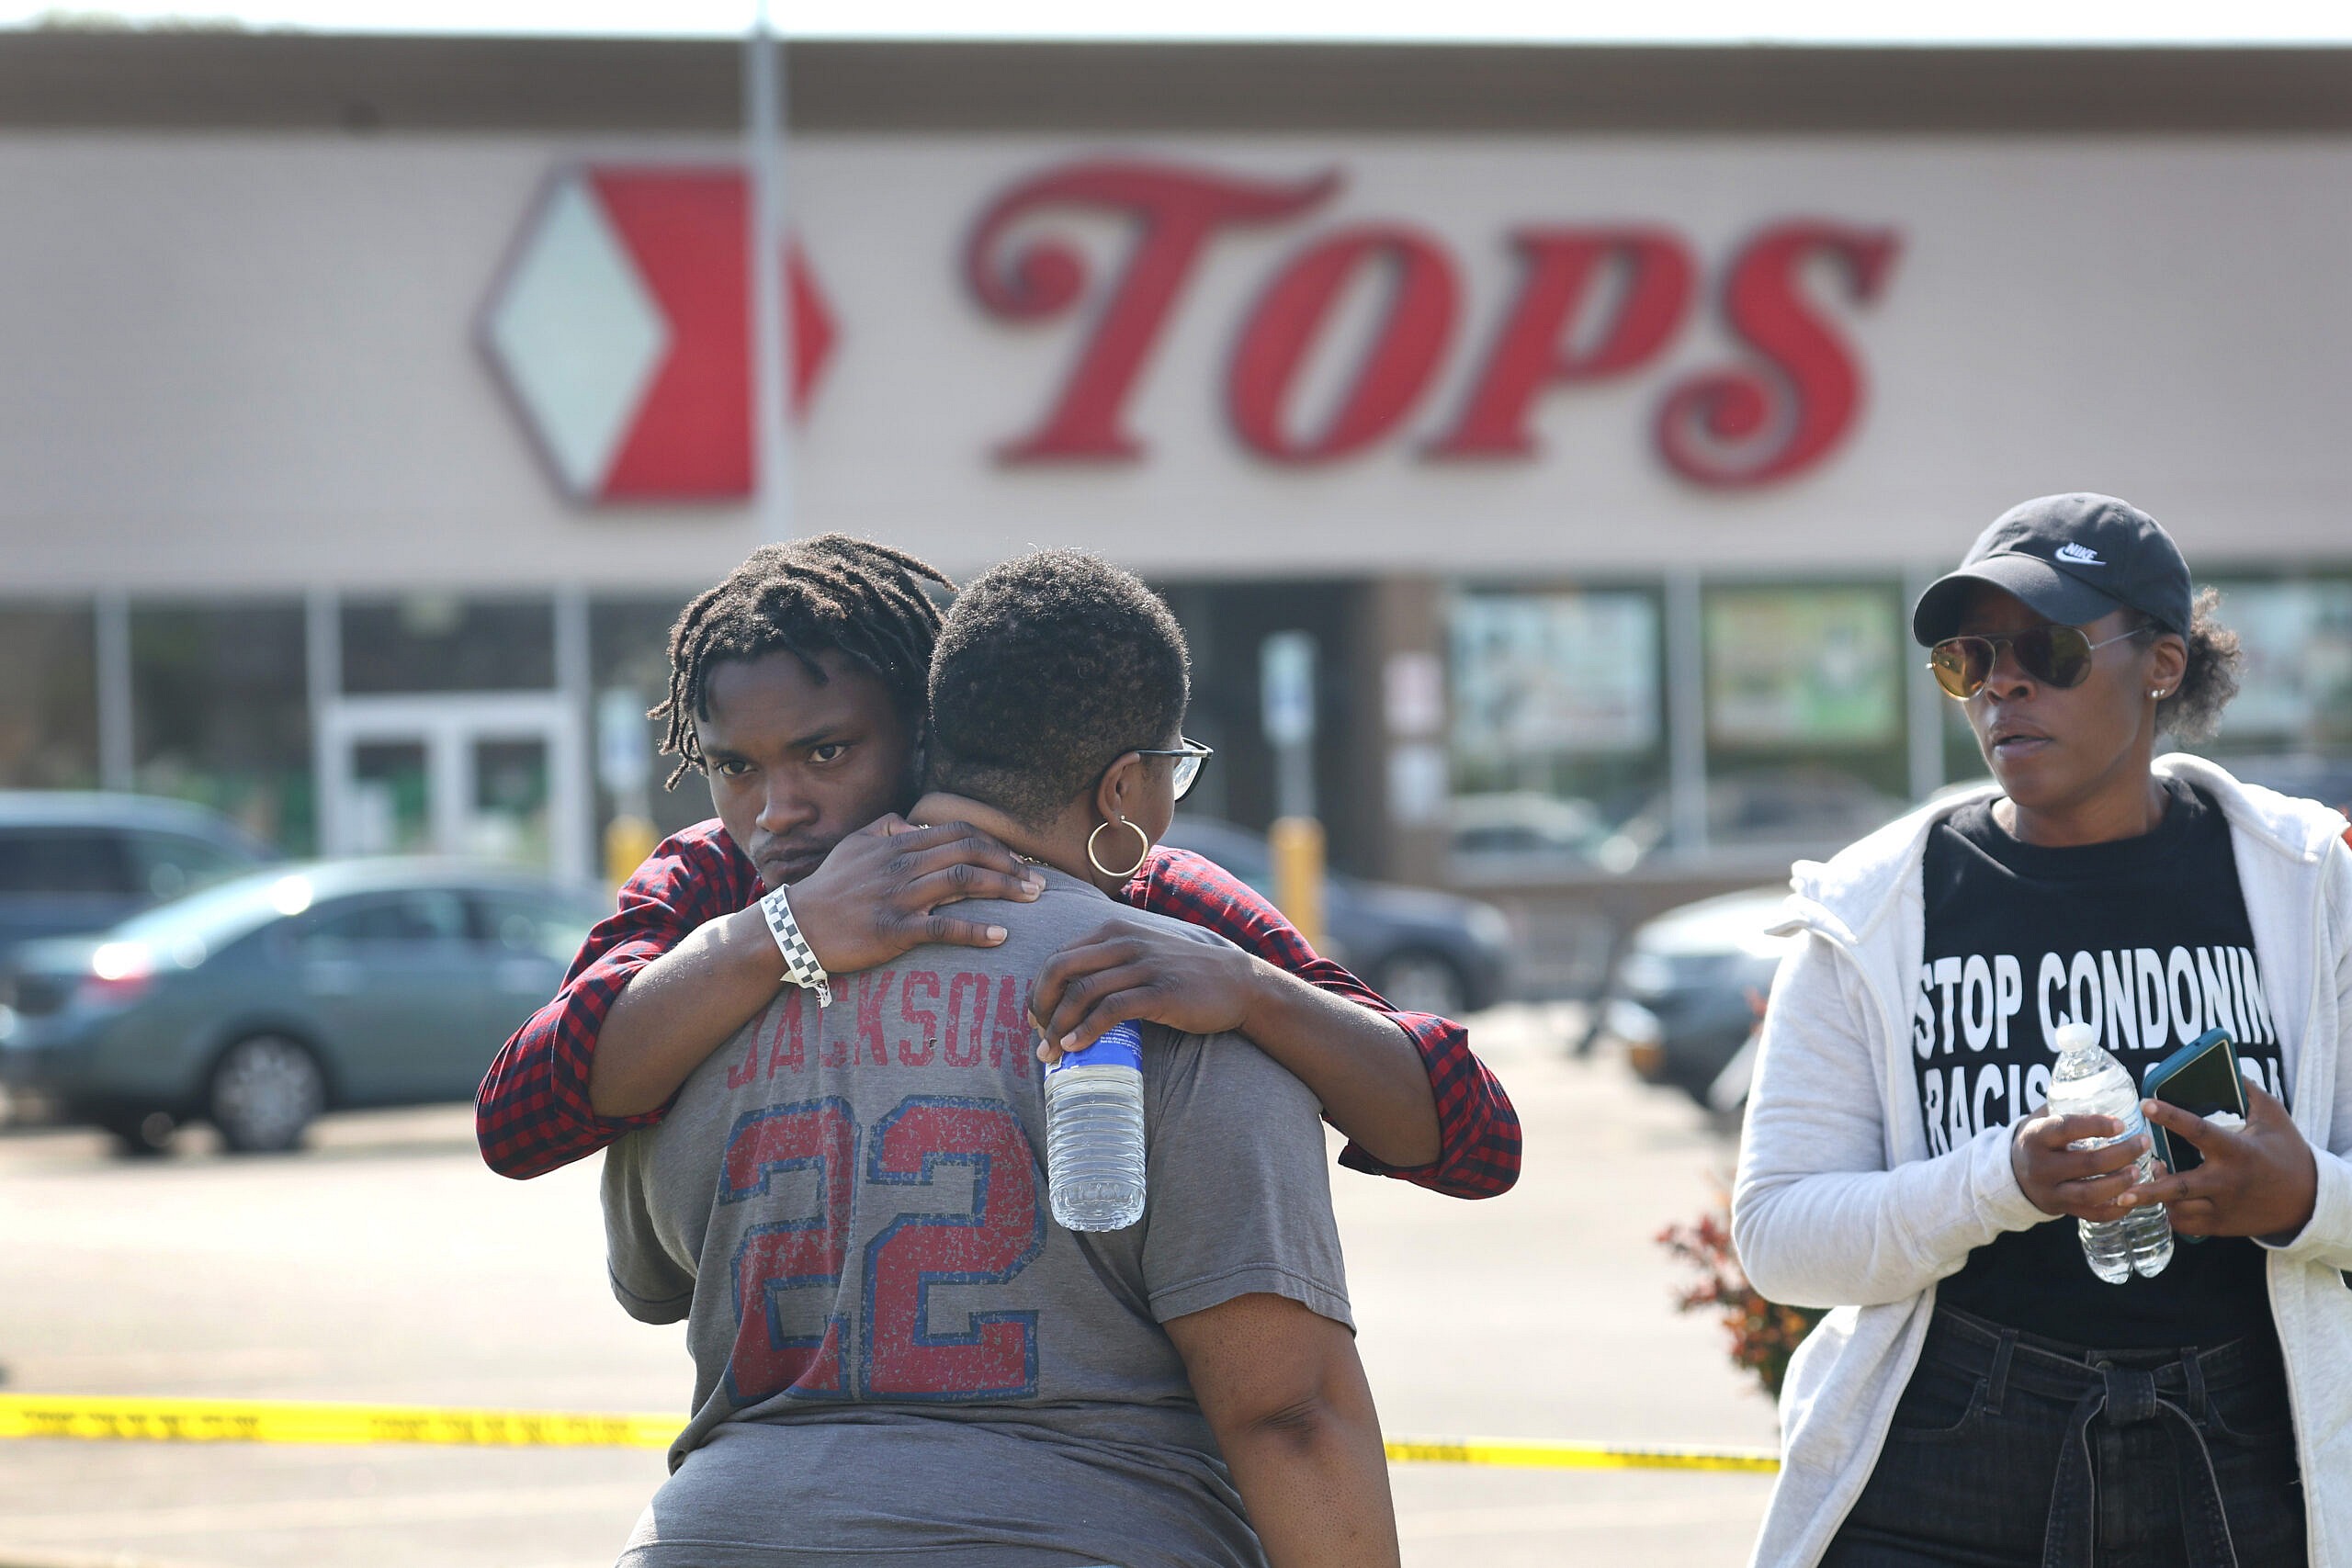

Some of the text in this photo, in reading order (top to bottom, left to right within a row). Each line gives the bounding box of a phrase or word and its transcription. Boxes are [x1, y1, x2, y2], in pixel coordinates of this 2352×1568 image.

[2064, 542, 2098, 560] NIKE
[727, 970, 1035, 1090] JACKSON
[1914, 944, 2275, 1059] STOP CONDONIN
[1925, 1062, 2054, 1159] RACIS
[719, 1093, 1047, 1406] 22
